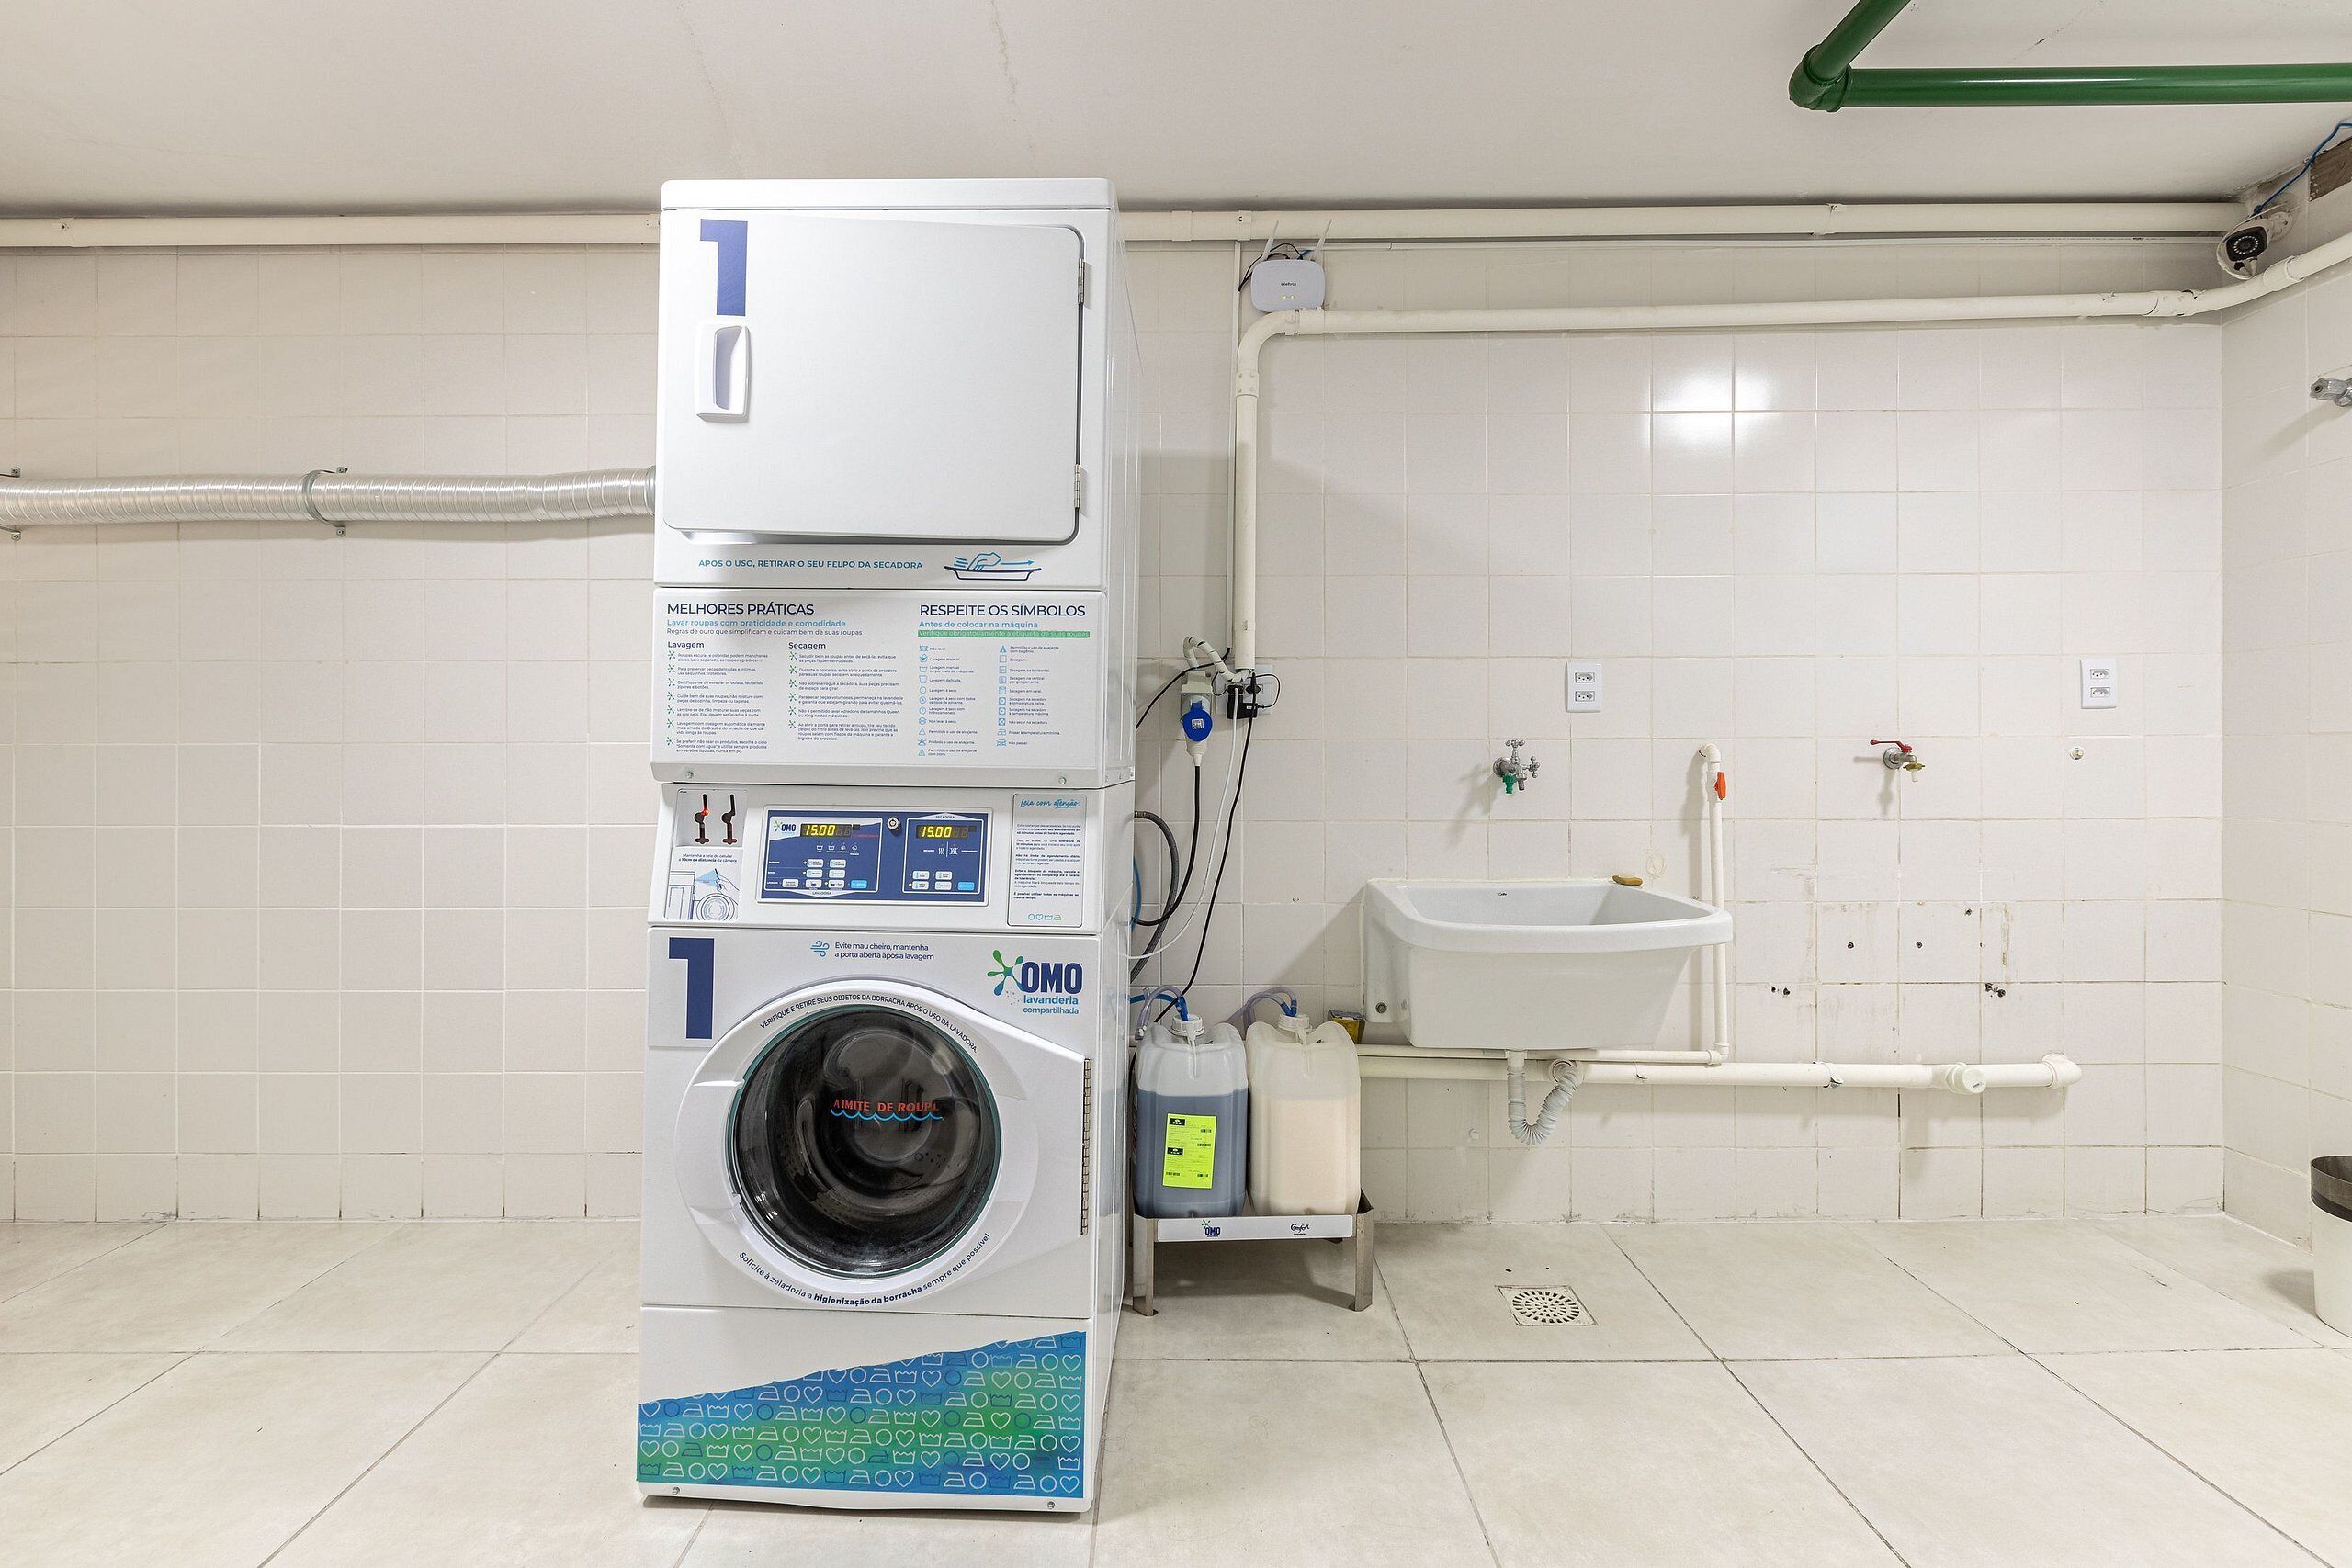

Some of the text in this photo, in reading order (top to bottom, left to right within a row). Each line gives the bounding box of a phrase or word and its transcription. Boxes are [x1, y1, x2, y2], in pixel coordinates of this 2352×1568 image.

[700, 219, 748, 317] 1
[735, 560, 756, 569] USO,
[667, 602, 815, 615] MELHORES PRÁTICAS
[920, 604, 1085, 616] RESPEITE OS SÍMBOLOS
[740, 620, 786, 628] praticidade
[1001, 622, 1038, 630] máquina
[668, 641, 704, 649] Lavagem
[788, 642, 826, 650] Secagem
[1020, 799, 1035, 807] Leia
[841, 952, 858, 960] porta
[905, 953, 934, 961] lavagem
[1022, 962, 1083, 994] OMO
[668, 937, 715, 1039] 1
[1023, 995, 1079, 1005] lavanderia
[1023, 1007, 1080, 1015] compartilhada
[760, 1008, 791, 1030] VERIFIQUE
[795, 999, 817, 1010] RETIRE
[818, 995, 833, 1004] SEUS
[871, 995, 905, 1007] BORRACHA
[906, 1001, 923, 1012] APÓS
[928, 1011, 942, 1021] USO
[941, 1018, 950, 1028] DA
[949, 1024, 978, 1054] LAVADORA.
[877, 1102, 894, 1112] DE
[1204, 1226, 1221, 1235] OMO
[740, 1252, 764, 1276] Solicite
[770, 1276, 807, 1297] zeladoria
[814, 1293, 871, 1306] higienização
[872, 1295, 883, 1303] da
[883, 1287, 922, 1301] borracha
[923, 1270, 952, 1291] sempre
[952, 1259, 967, 1272] que
